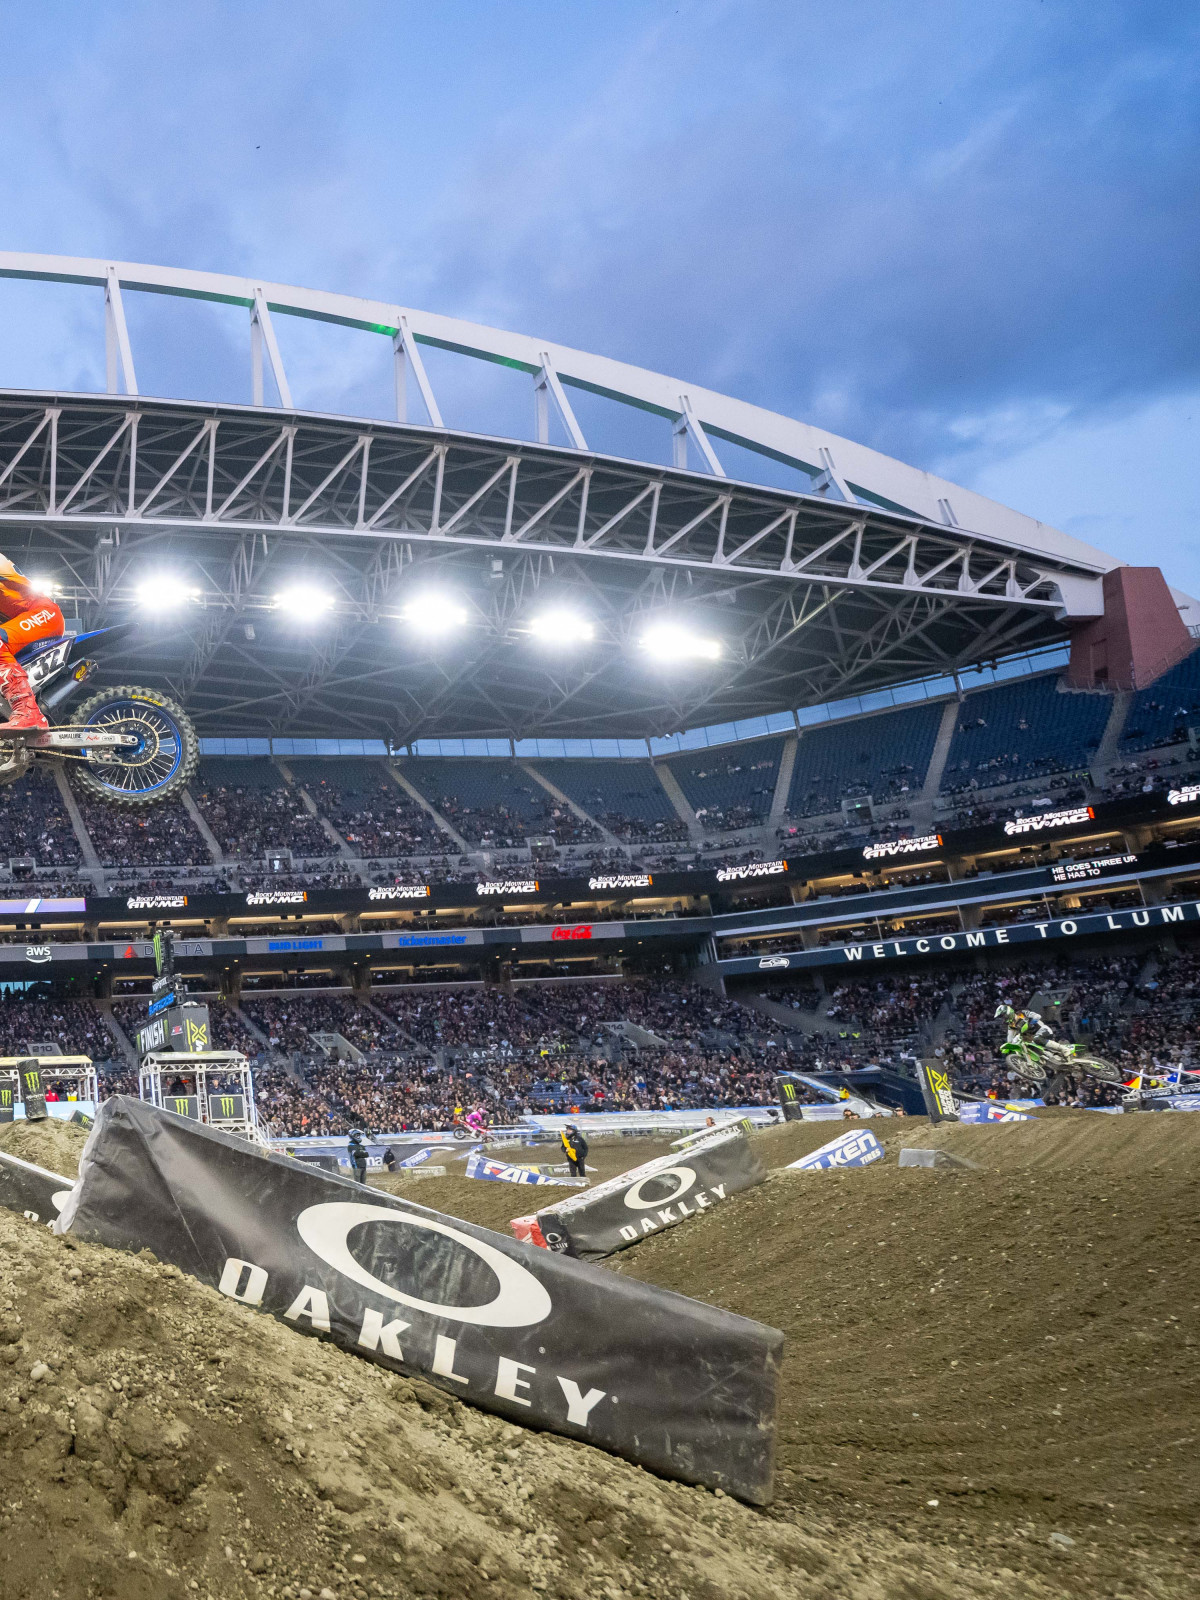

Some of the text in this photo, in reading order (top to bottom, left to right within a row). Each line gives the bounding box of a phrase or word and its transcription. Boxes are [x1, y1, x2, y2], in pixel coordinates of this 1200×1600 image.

[32, 648, 62, 681] 32
[1016, 807, 1087, 825] ROCKY MOUNTAIN
[874, 836, 937, 850] ROCKY MOUNTAIN
[726, 861, 782, 873] ROCKY MOUNTAIN
[1052, 865, 1065, 874] HE
[1066, 862, 1091, 873] GOES
[1092, 858, 1122, 869] THREE
[1054, 868, 1100, 882] HE HAS TO
[293, 940, 323, 949] LIGHT
[399, 933, 467, 947] ticketmaster
[844, 929, 1009, 961] WELCOME
[1035, 920, 1078, 939] TO
[26, 947, 51, 956] aws
[145, 943, 204, 955] DLTA
[605, 1023, 624, 1031] 14
[140, 1018, 164, 1053] FINISH
[801, 1133, 878, 1170] LKEN
[860, 1149, 881, 1165] TIRES
[619, 1184, 726, 1241] OAKLEY
[218, 1258, 607, 1426] OAKLEY
